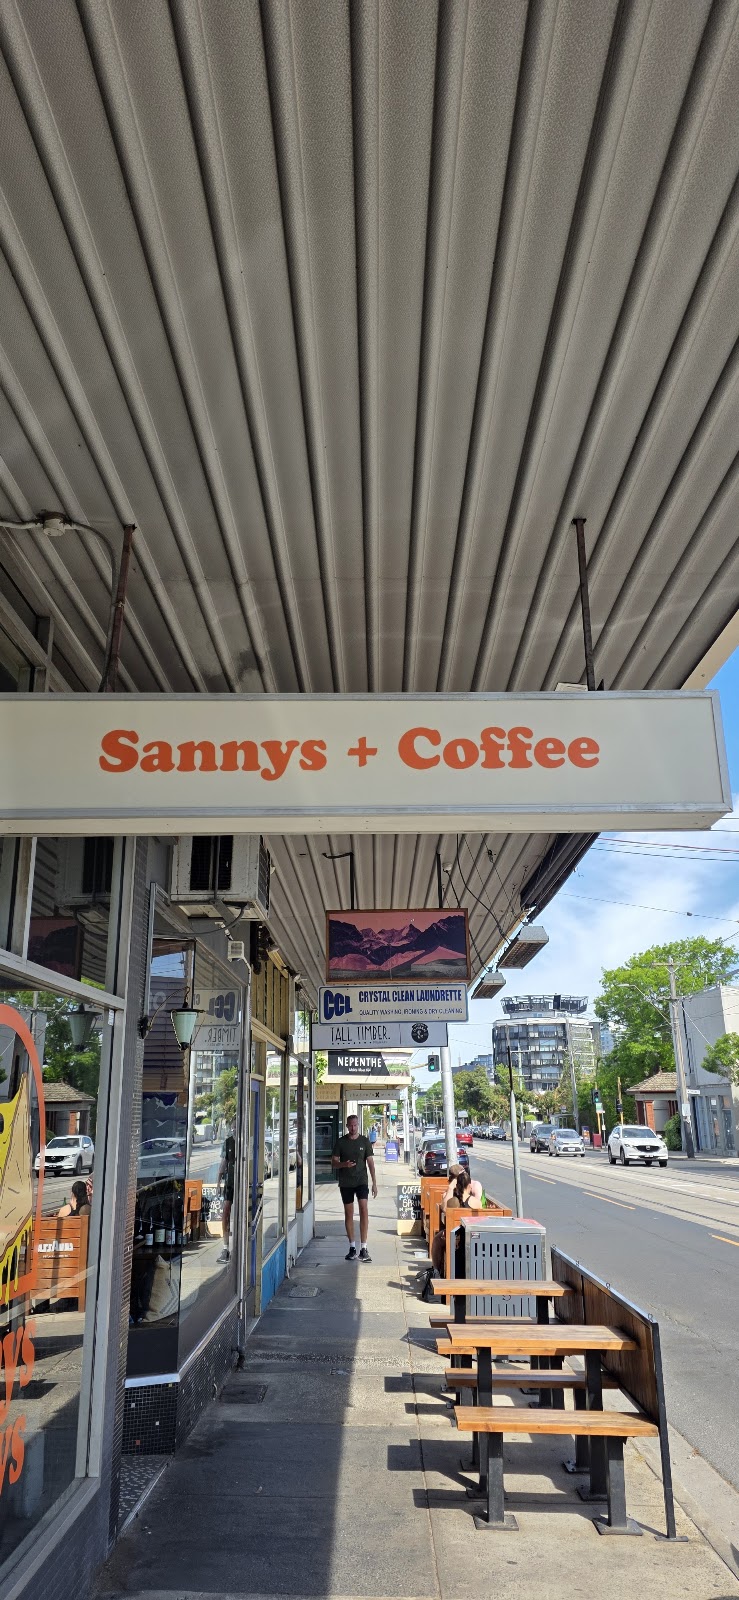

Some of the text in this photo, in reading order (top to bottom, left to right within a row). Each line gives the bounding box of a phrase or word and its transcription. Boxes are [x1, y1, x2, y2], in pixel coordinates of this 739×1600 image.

[100, 727, 598, 780] Sannys + Coffee
[359, 989, 462, 1002] CRYSTAL CLEAN LAUNDRETTE
[324, 990, 352, 1020] CCL
[331, 1027, 352, 1042] TALL
[337, 1056, 382, 1067] NEPENTHE
[402, 1186, 421, 1194] COFFE
